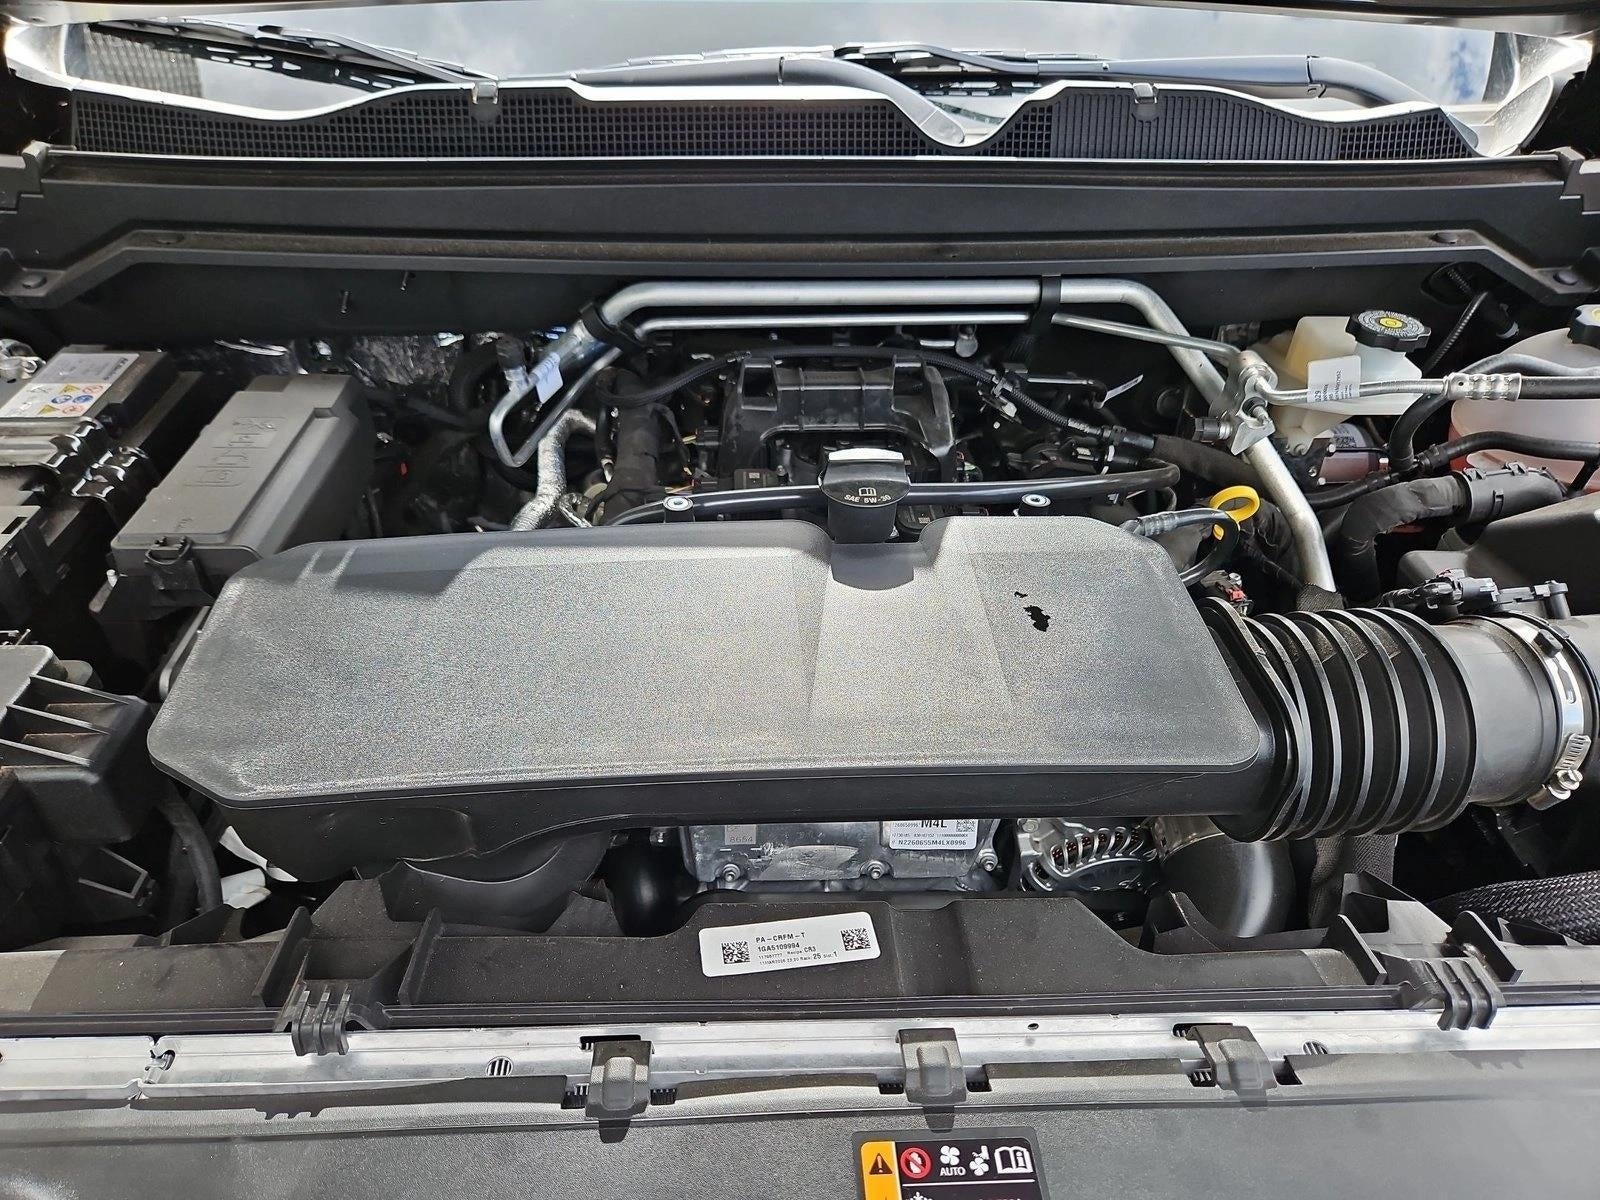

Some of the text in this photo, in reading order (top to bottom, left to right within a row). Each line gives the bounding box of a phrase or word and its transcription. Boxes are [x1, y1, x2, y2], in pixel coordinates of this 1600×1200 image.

[844, 494, 892, 503] SAE 5W-30
[921, 819, 947, 828] M4L
[939, 1166, 966, 1176] AUTO
